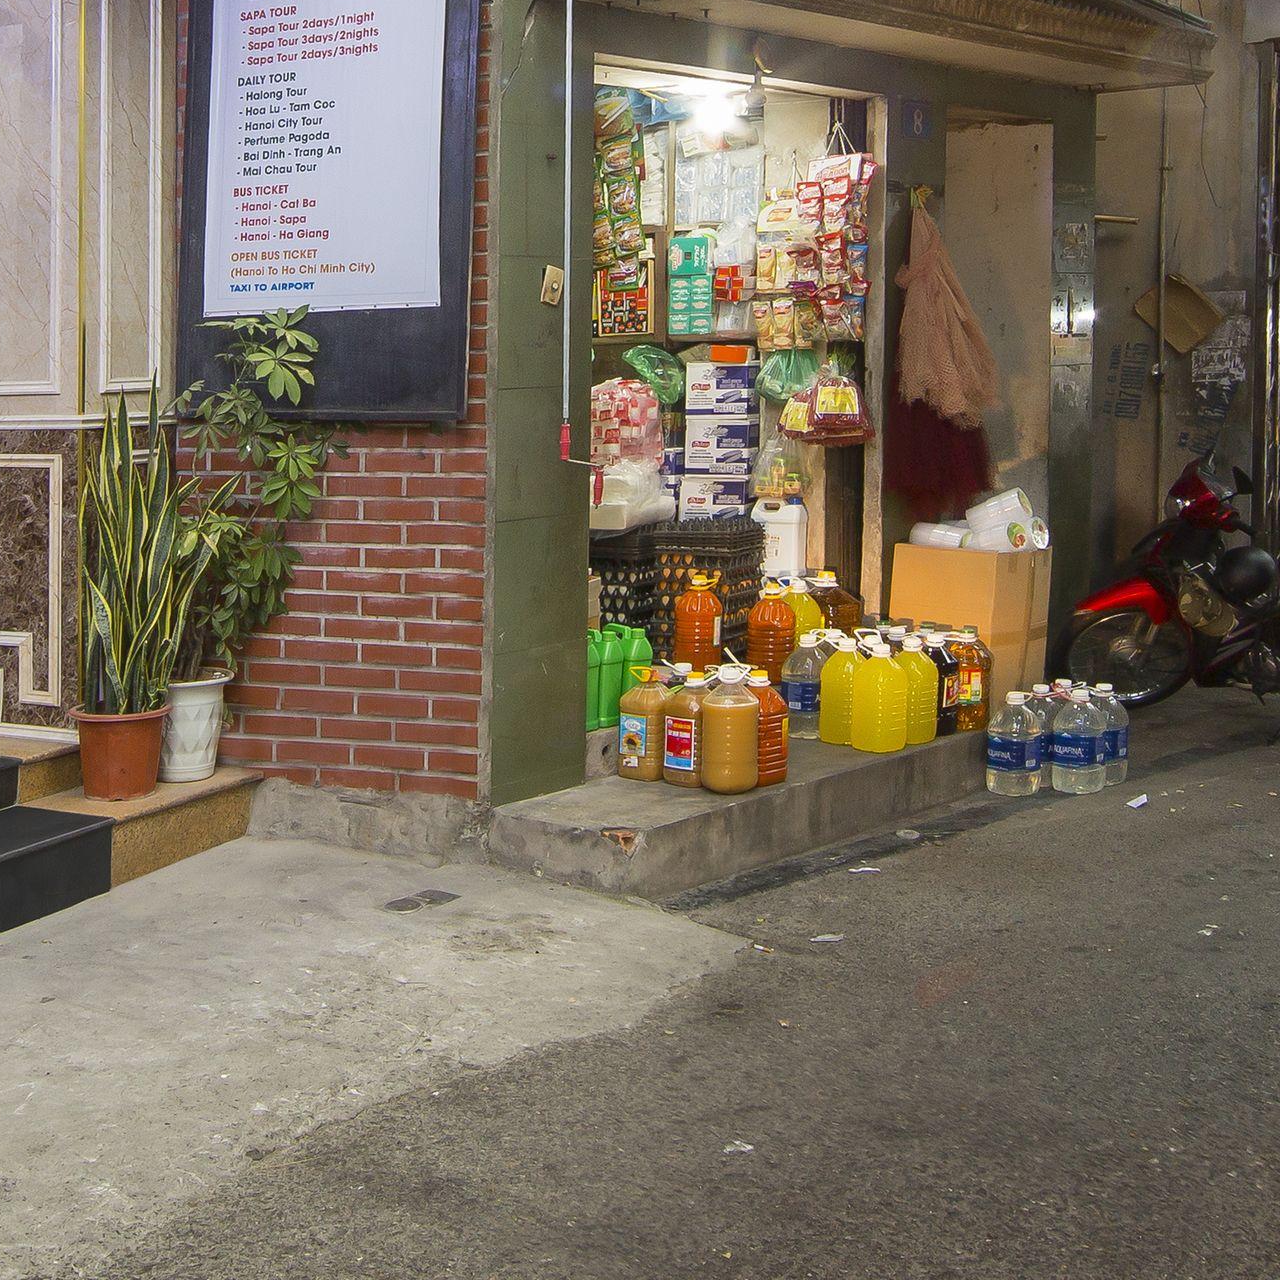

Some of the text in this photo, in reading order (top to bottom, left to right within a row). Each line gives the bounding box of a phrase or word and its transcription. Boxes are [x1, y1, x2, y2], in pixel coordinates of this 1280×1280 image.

[240, 6, 297, 22] SAPA TOUR
[248, 25, 275, 37] Sapa
[278, 22, 299, 33] Tour
[302, 11, 375, 29] 2days/1night
[248, 40, 274, 52] Sapa
[278, 37, 298, 48] Tour
[301, 26, 379, 45] 3days/2nights
[247, 55, 274, 67] Sapa
[277, 51, 298, 62] Tour
[301, 42, 378, 61] 2days/3nights
[238, 72, 297, 87] DAILY TOUR
[246, 90, 283, 101] Halong
[286, 87, 308, 97] Tour
[245, 107, 266, 116] Hoa
[269, 104, 280, 114] Lu
[289, 102, 310, 112] Tam
[313, 99, 336, 110] Coc
[278, 118, 299, 129] City
[301, 116, 323, 126] Tour
[914, 109, 922, 135] 8
[244, 135, 285, 146] Perfume
[288, 131, 330, 144] Pagoda
[243, 151, 260, 161] Bai
[262, 149, 285, 160] Dinh
[294, 147, 324, 158] Trang
[327, 145, 342, 155] An
[243, 167, 261, 177] Mai
[264, 165, 292, 175] Chau
[295, 163, 317, 173] Tour
[233, 184, 289, 197] BUS TICKET
[241, 201, 271, 212] Hanoi
[280, 200, 299, 209] Cat
[302, 199, 316, 208] Ba
[241, 216, 271, 227] Hanoi
[279, 215, 307, 225] Sapa
[240, 231, 270, 242] Hanoi
[279, 230, 294, 240] Ha
[297, 229, 329, 240] Giang
[231, 249, 318, 262] OPEN BUS TICKET
[230, 262, 375, 279] (Hanoi To Ho Chi Minh City)
[230, 282, 314, 292] TAXI TO AIRPORT
